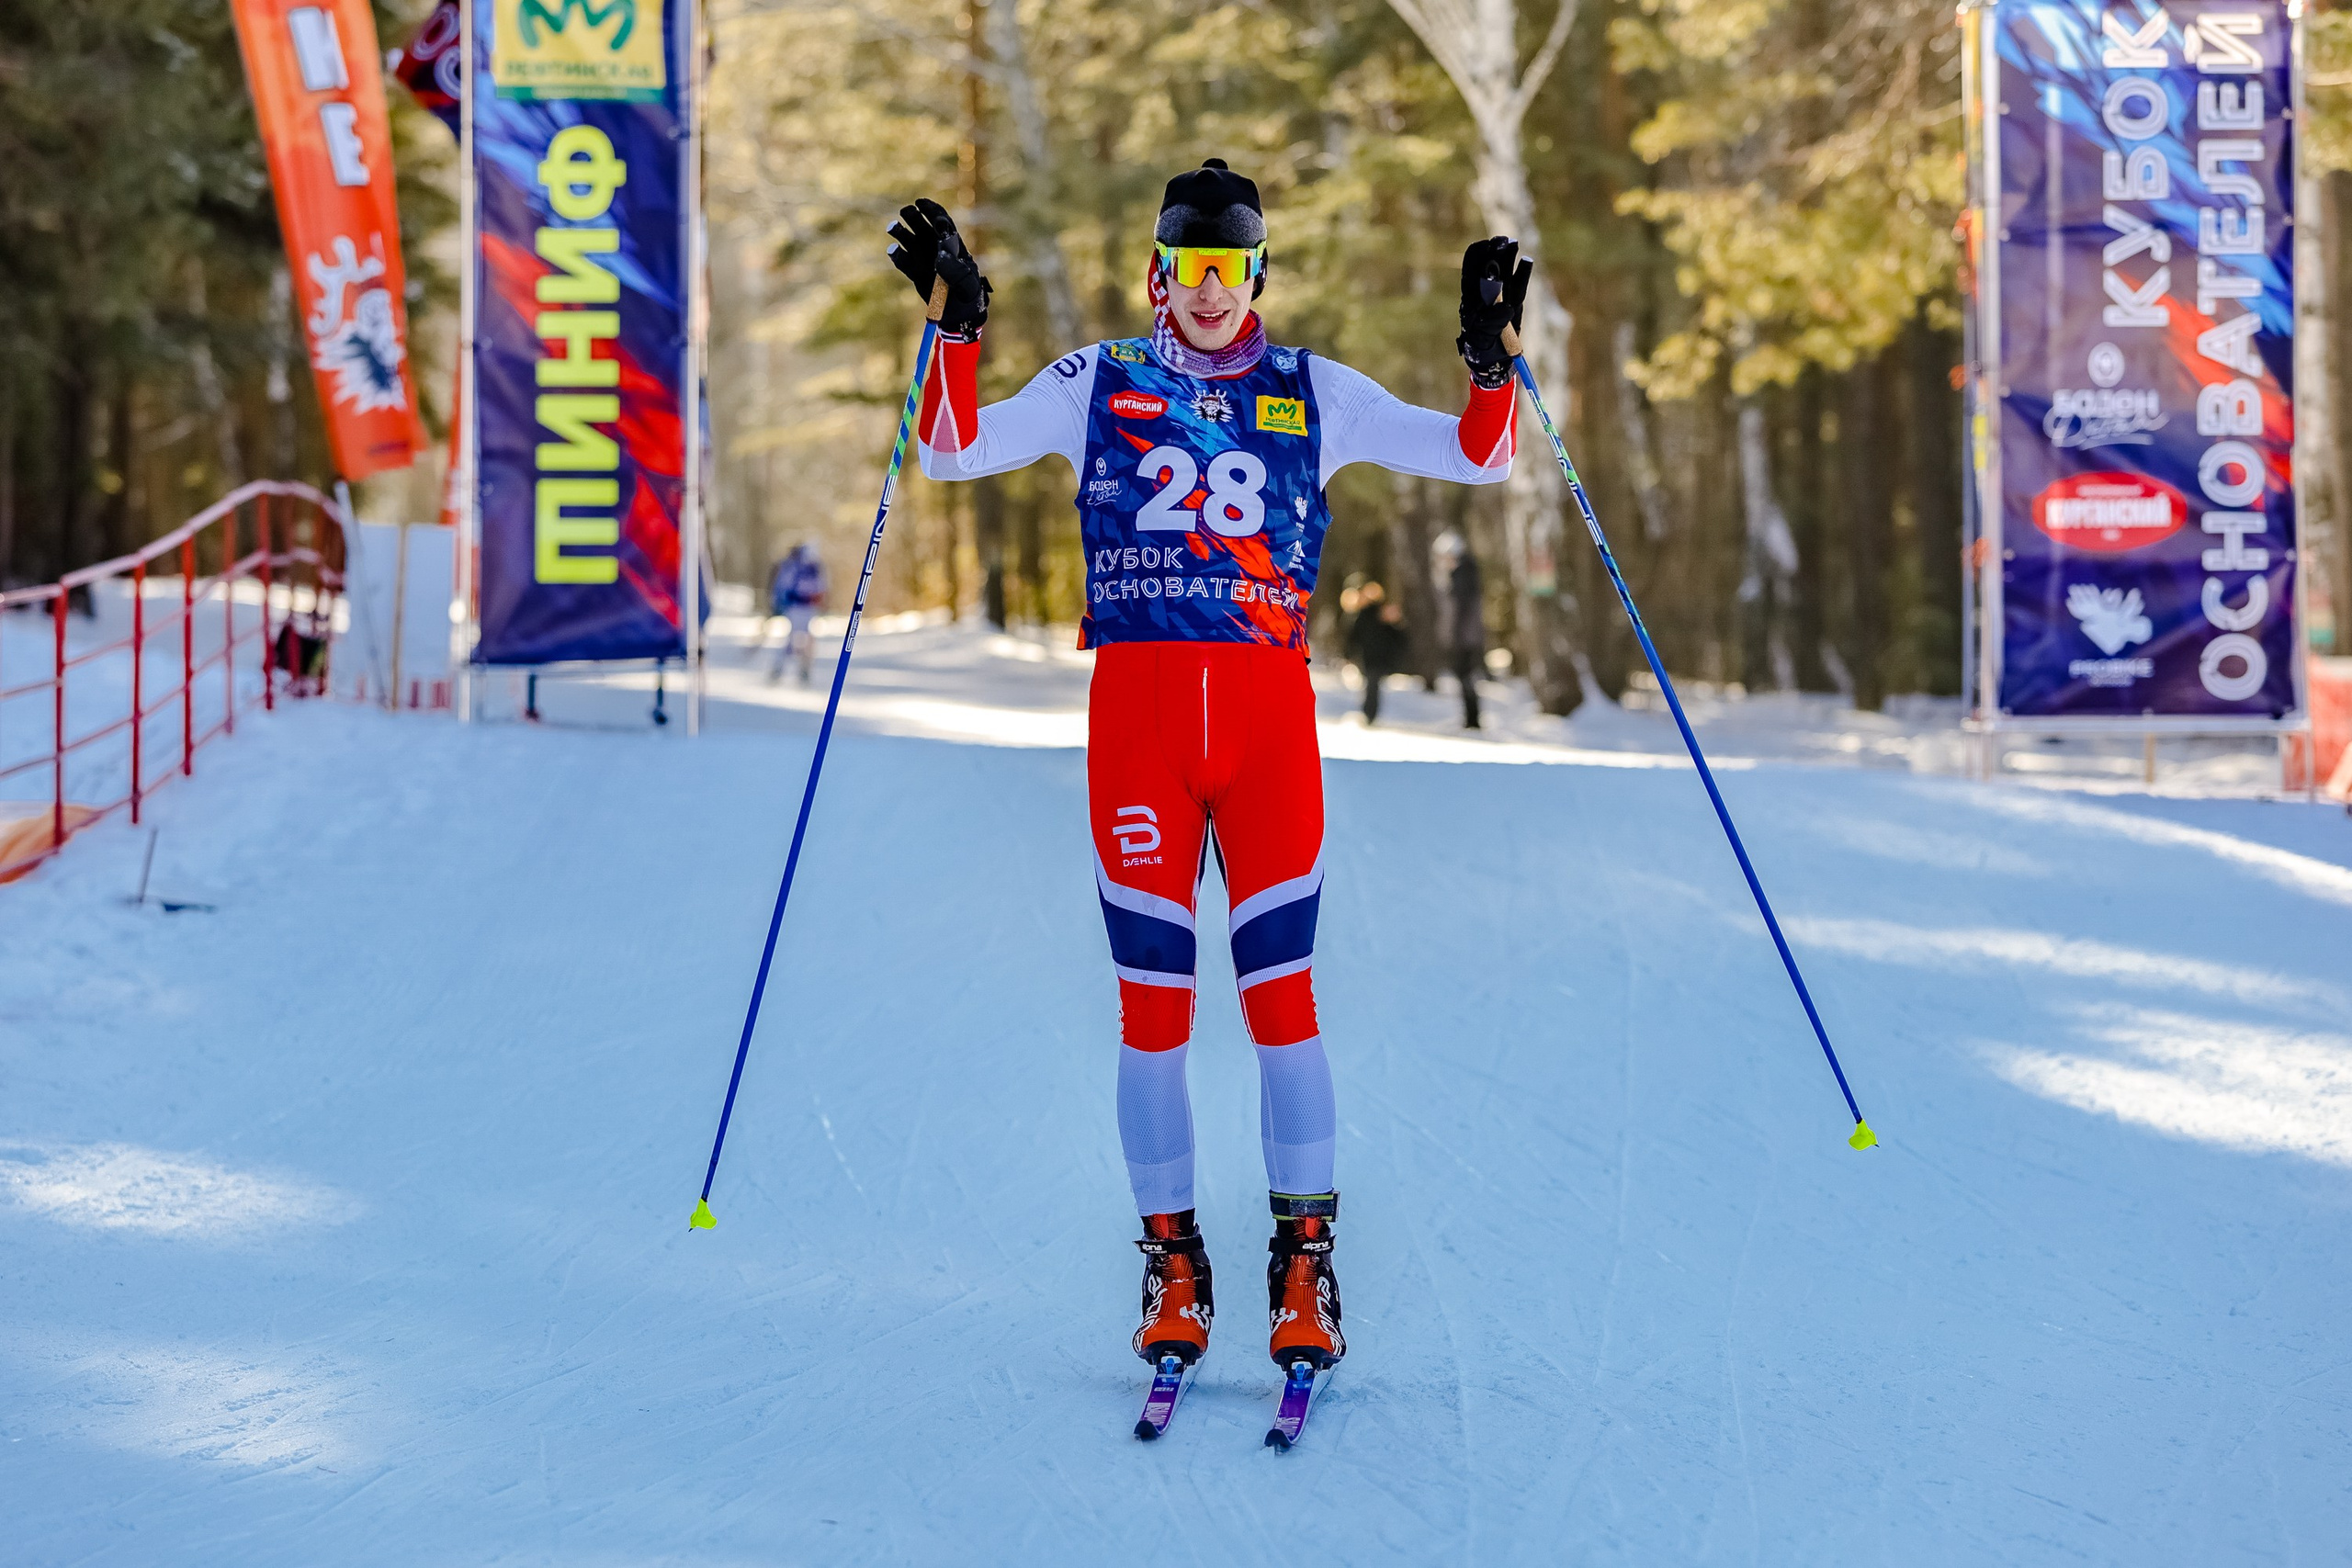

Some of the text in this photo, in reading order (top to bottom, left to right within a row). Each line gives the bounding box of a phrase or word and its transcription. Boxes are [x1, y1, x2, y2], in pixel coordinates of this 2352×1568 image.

[2102, 7, 2170, 328] КУБОК
[534, 124, 627, 585] ФИНИШ
[2183, 12, 2268, 702] ОСНОВАТЕЛЕЙ
[1114, 398, 1163, 413] КУРГАНСКИЙ
[1136, 445, 1268, 538] 28
[1092, 576, 1300, 610] ОСНОВАТЕЛЕЙ
[1094, 546, 1184, 574] КУБОК
